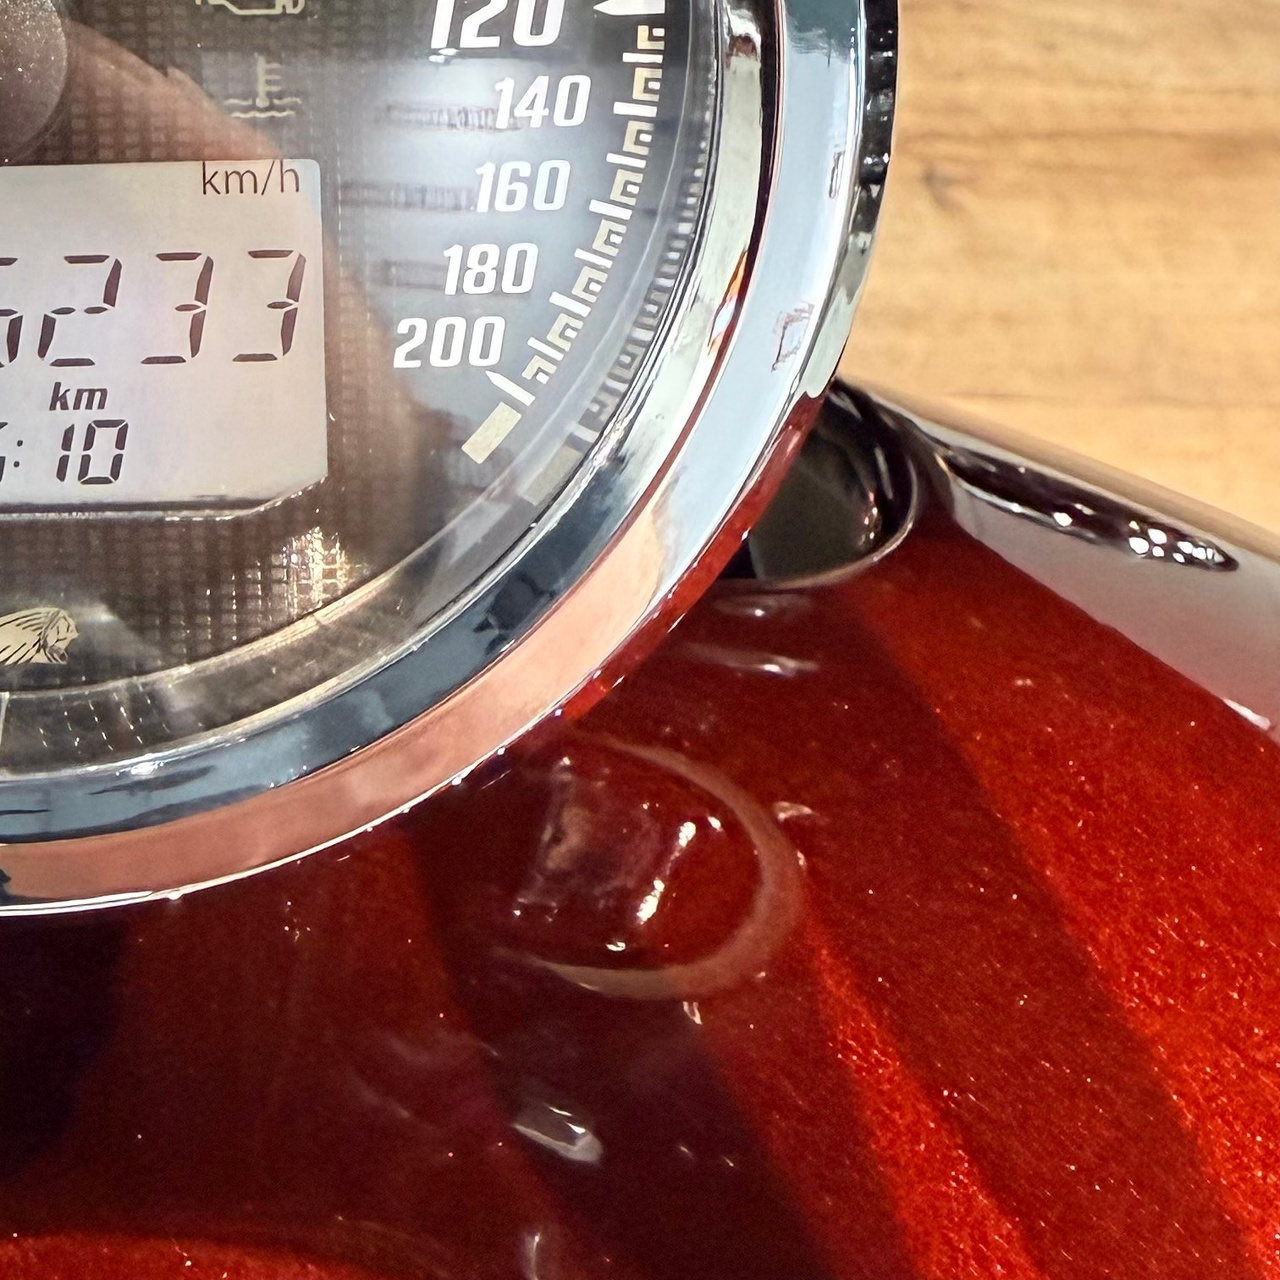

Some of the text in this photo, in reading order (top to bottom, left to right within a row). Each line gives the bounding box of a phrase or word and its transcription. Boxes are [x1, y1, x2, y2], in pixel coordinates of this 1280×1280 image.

[494, 74, 591, 128] 140
[202, 160, 300, 196] km/h
[475, 159, 571, 212] 160
[443, 242, 539, 296] 180
[393, 315, 506, 369] 200
[49, 381, 108, 411] km
